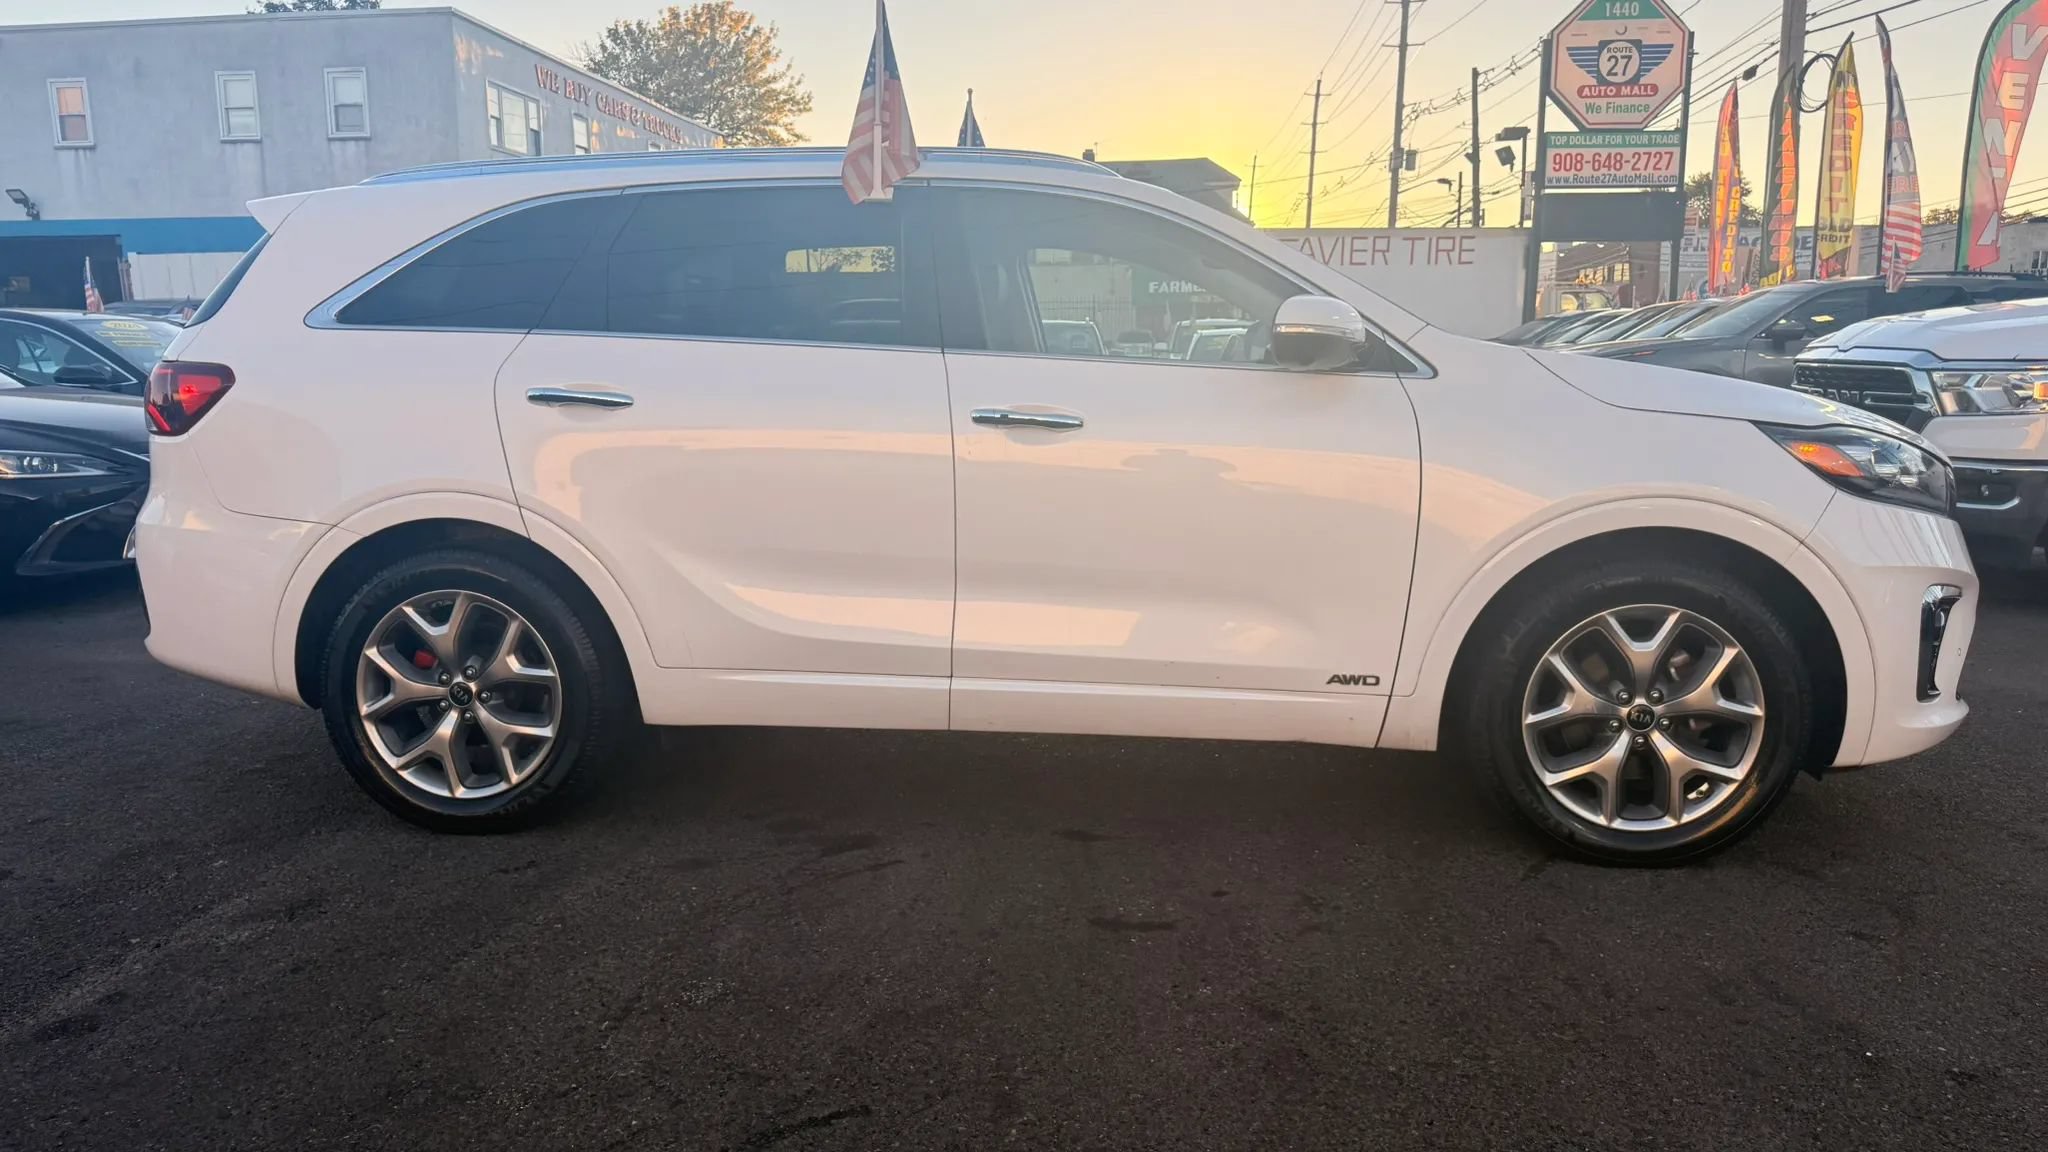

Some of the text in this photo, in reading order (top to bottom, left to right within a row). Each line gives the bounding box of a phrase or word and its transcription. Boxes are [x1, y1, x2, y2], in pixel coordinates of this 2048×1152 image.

[1605, 2, 1639, 17] 1440
[1606, 46, 1633, 55] ROUTE
[1606, 55, 1633, 77] 27
[1581, 84, 1654, 97] AUTO MALL
[535, 63, 560, 94] WE
[563, 77, 592, 107] BUY
[596, 91, 630, 121] CARS
[641, 110, 684, 144] TRUCKS
[1585, 101, 1650, 115] We Finance
[1551, 134, 1680, 145] TOP DOLLAR FOR YOUR TRADE
[1976, 23, 2048, 247] VENA
[1552, 151, 1674, 173] 908-648-2727
[1546, 173, 1678, 186] www.Route27AutoMall.com
[1280, 235, 1476, 266] AVIER TIRE
[1148, 280, 1206, 294] FARM
[1326, 673, 1381, 687] AWD
[453, 685, 469, 704] KIA
[1630, 711, 1651, 723] KIA
